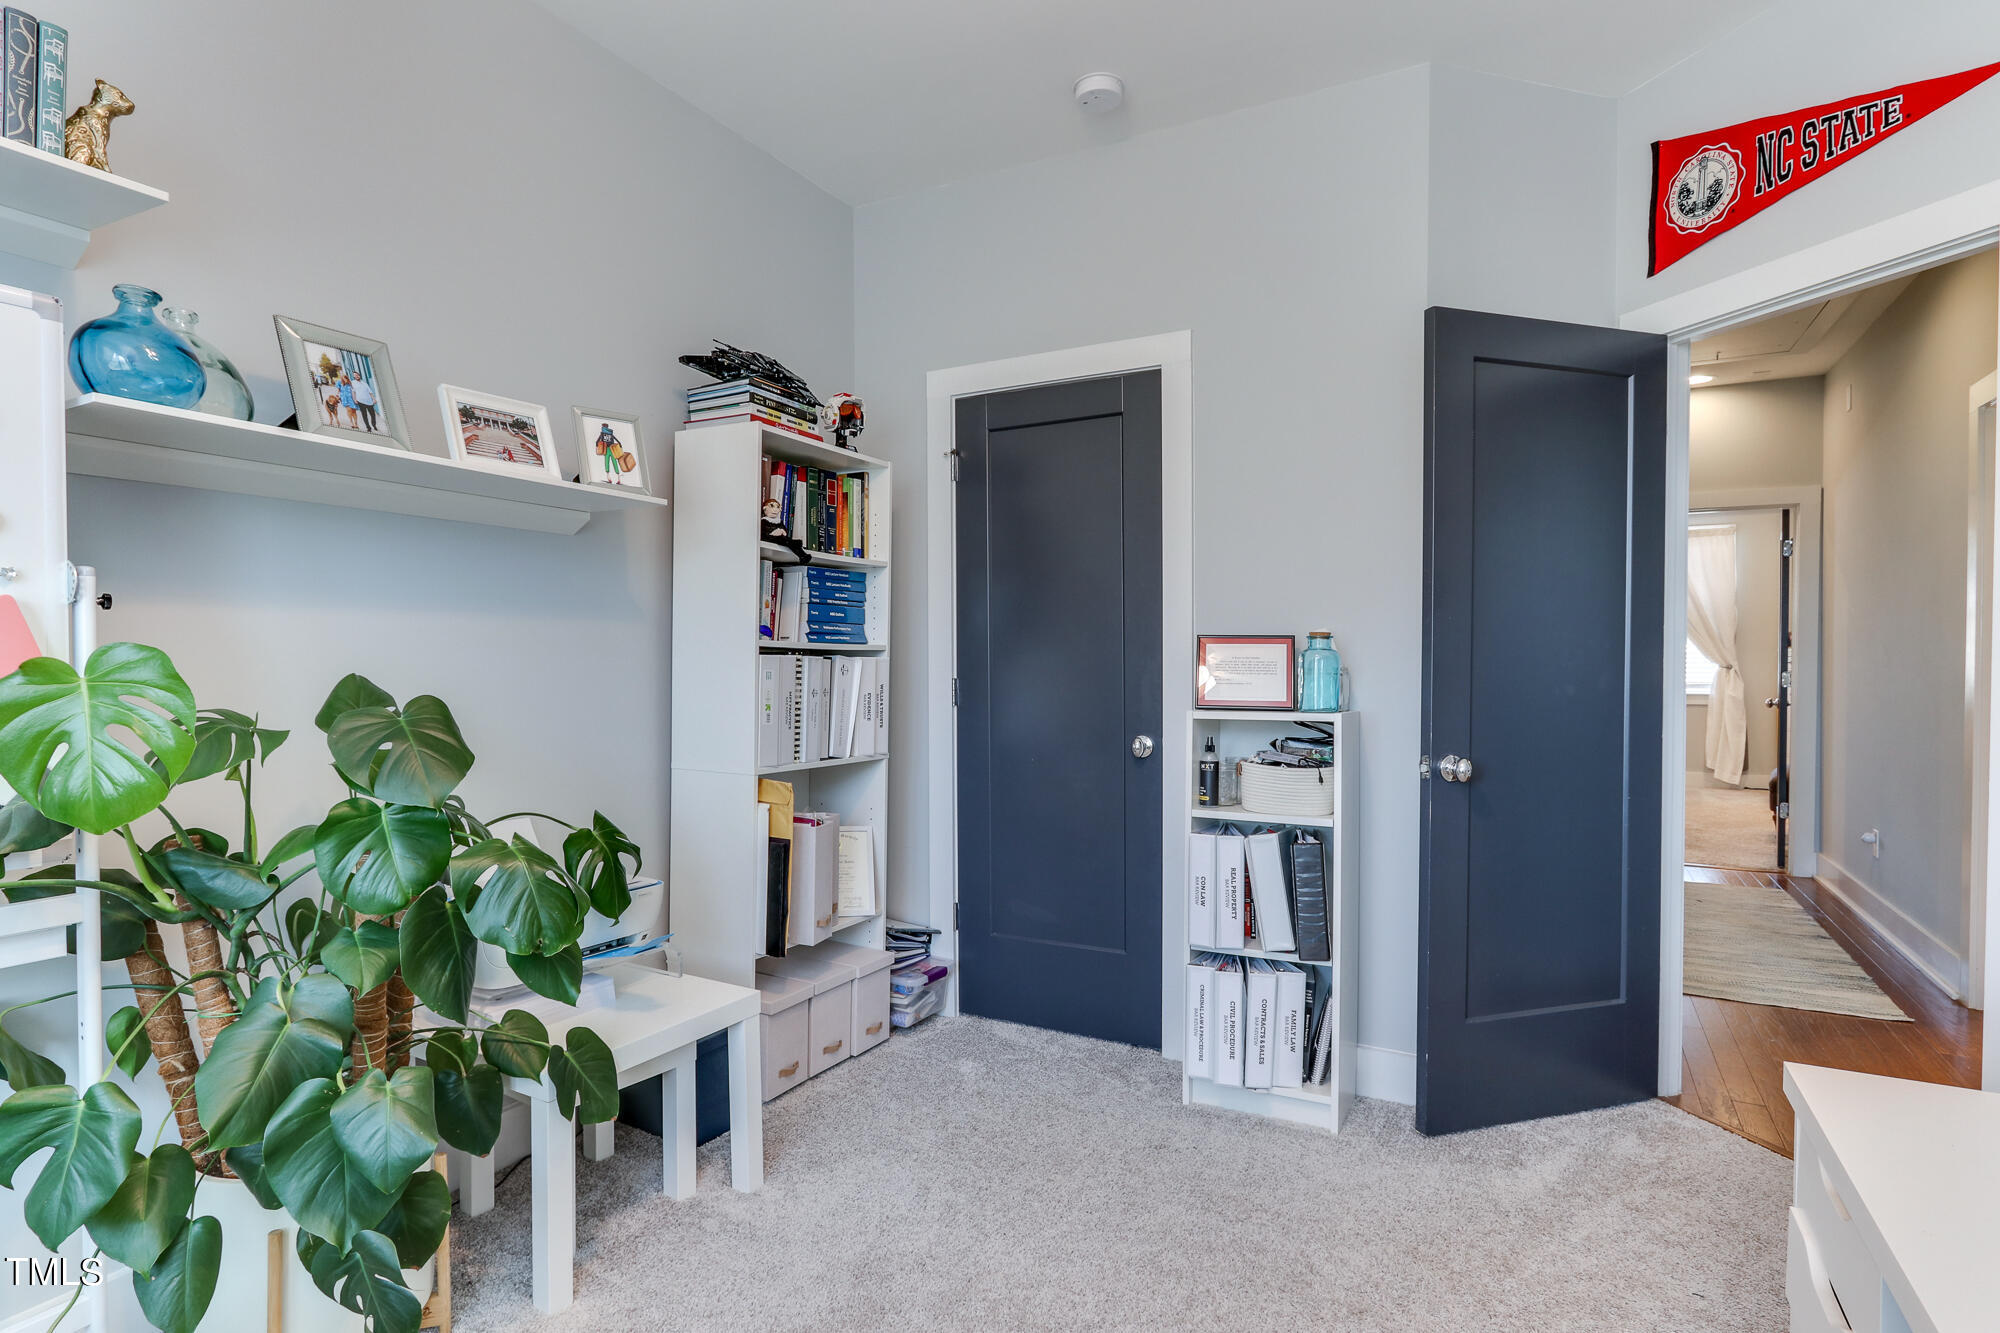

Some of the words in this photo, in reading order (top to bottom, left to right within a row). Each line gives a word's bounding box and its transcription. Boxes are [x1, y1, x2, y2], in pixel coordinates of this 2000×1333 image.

[1754, 126, 1794, 197] NC
[1800, 95, 1903, 171] STATE
[1676, 202, 1726, 227] UNIVERSITY
[1260, 998, 1268, 1039] CONTRACTS
